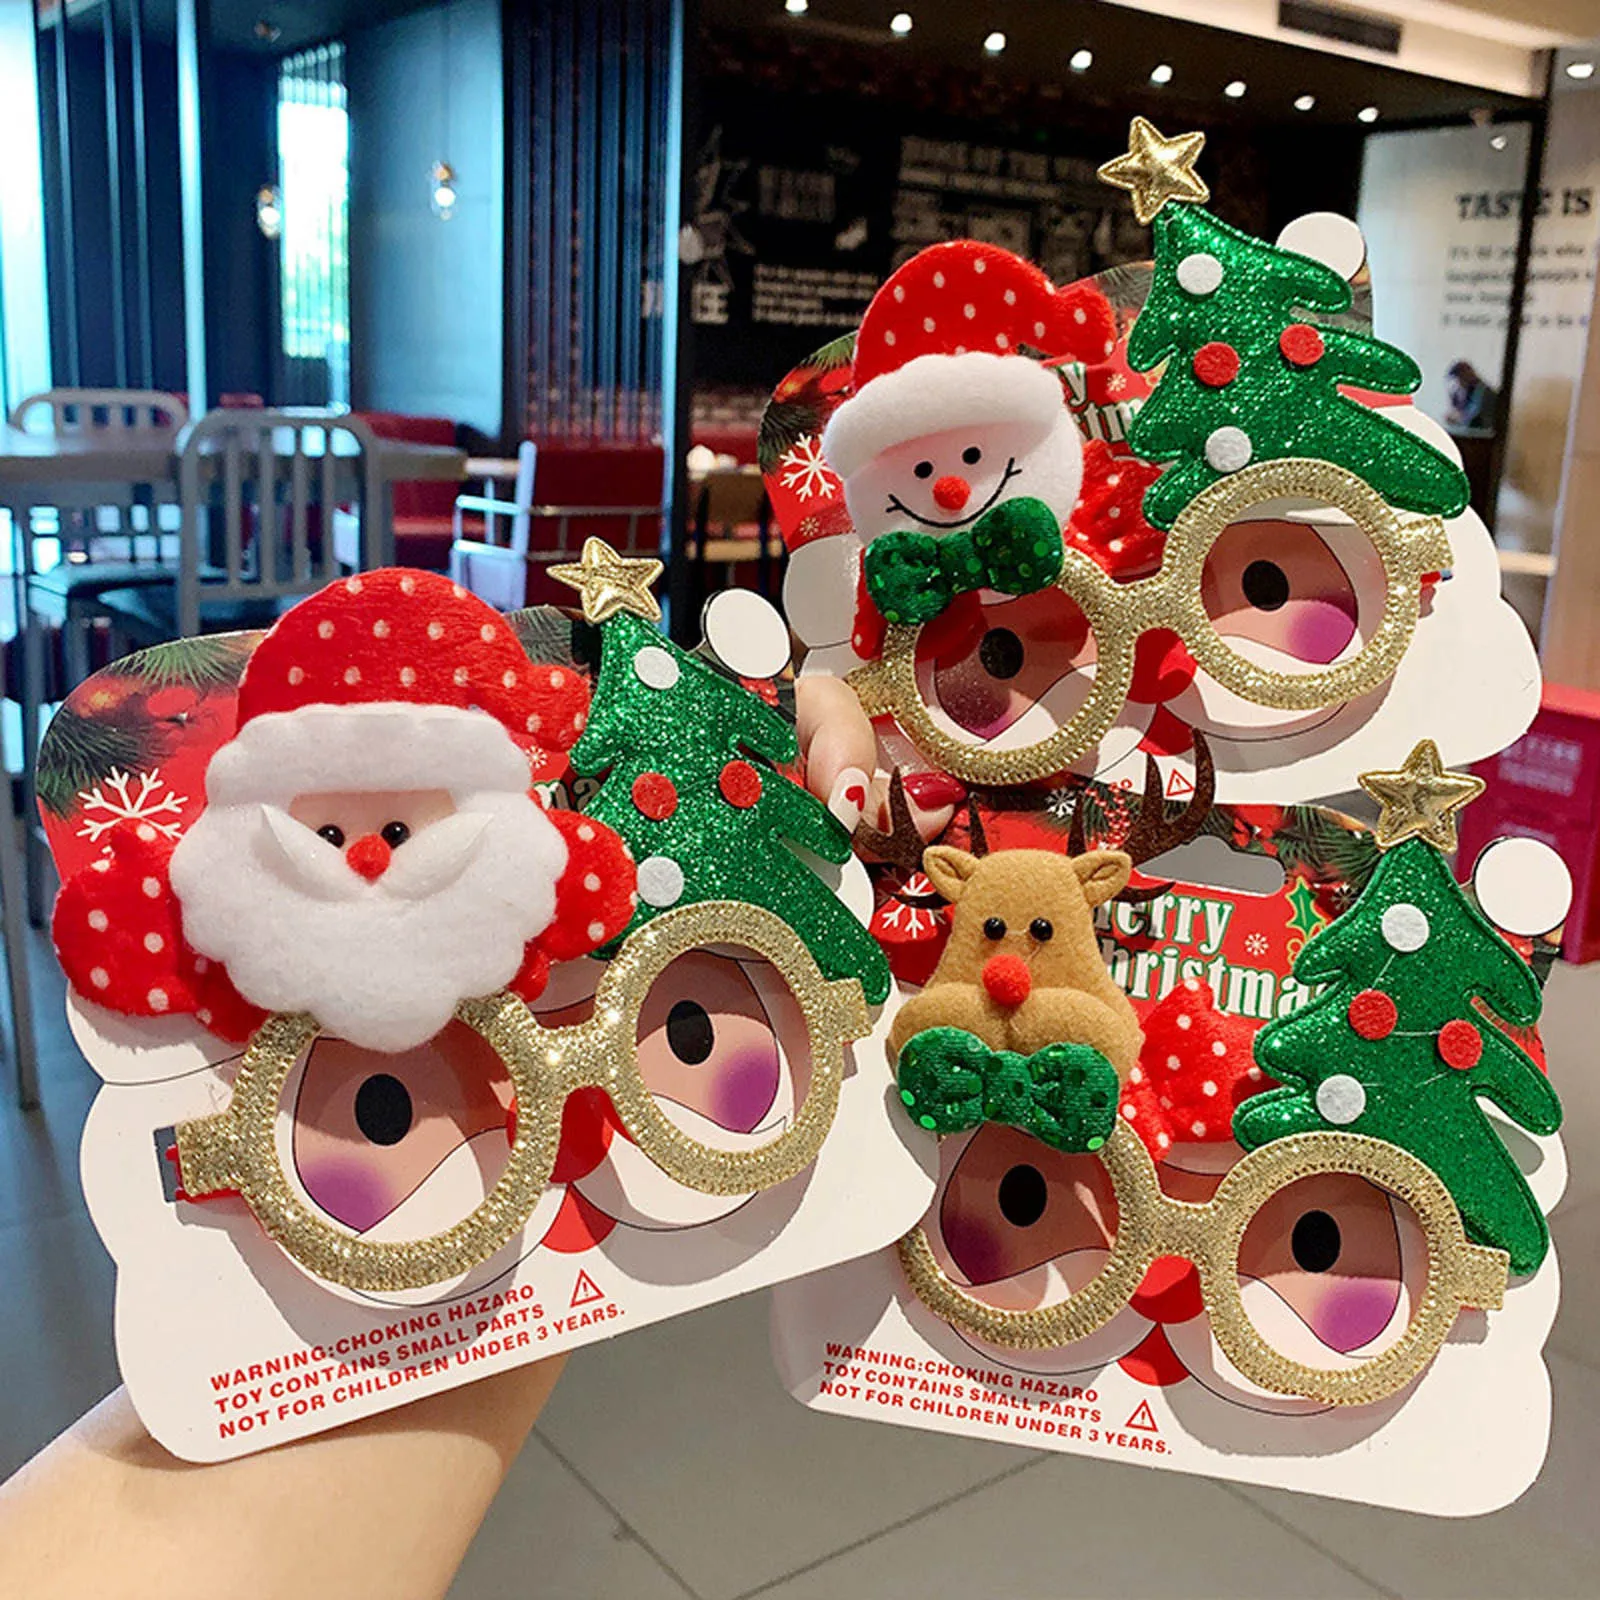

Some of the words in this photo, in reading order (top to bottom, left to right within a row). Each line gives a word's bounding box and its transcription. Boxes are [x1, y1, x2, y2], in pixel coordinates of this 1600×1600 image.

[1561, 186, 1593, 216] IS
[1094, 893, 1234, 955] erry
[215, 1388, 263, 1414] TOY
[269, 1350, 391, 1398] CONTAINS
[396, 1328, 470, 1361] SMALL
[475, 1304, 544, 1337] PARTS
[219, 1410, 269, 1438] NOT
[277, 1394, 326, 1421] FOR
[332, 1355, 449, 1403] CHILDREN
[455, 1331, 530, 1366] UNDER
[536, 1326, 548, 1340] 3
[553, 1303, 626, 1334] YEARS.
[823, 1361, 861, 1379] TOY
[865, 1369, 964, 1398] CONTAINS
[969, 1388, 1032, 1411] SMALL
[1039, 1400, 1101, 1423] PARTS
[819, 1380, 860, 1399] NOT
[865, 1389, 904, 1407] FOR
[909, 1397, 1009, 1426] CHILDREN
[1015, 1416, 1082, 1439] UNDER
[1088, 1429, 1099, 1442] 3
[1105, 1431, 1172, 1455] YEARS.
